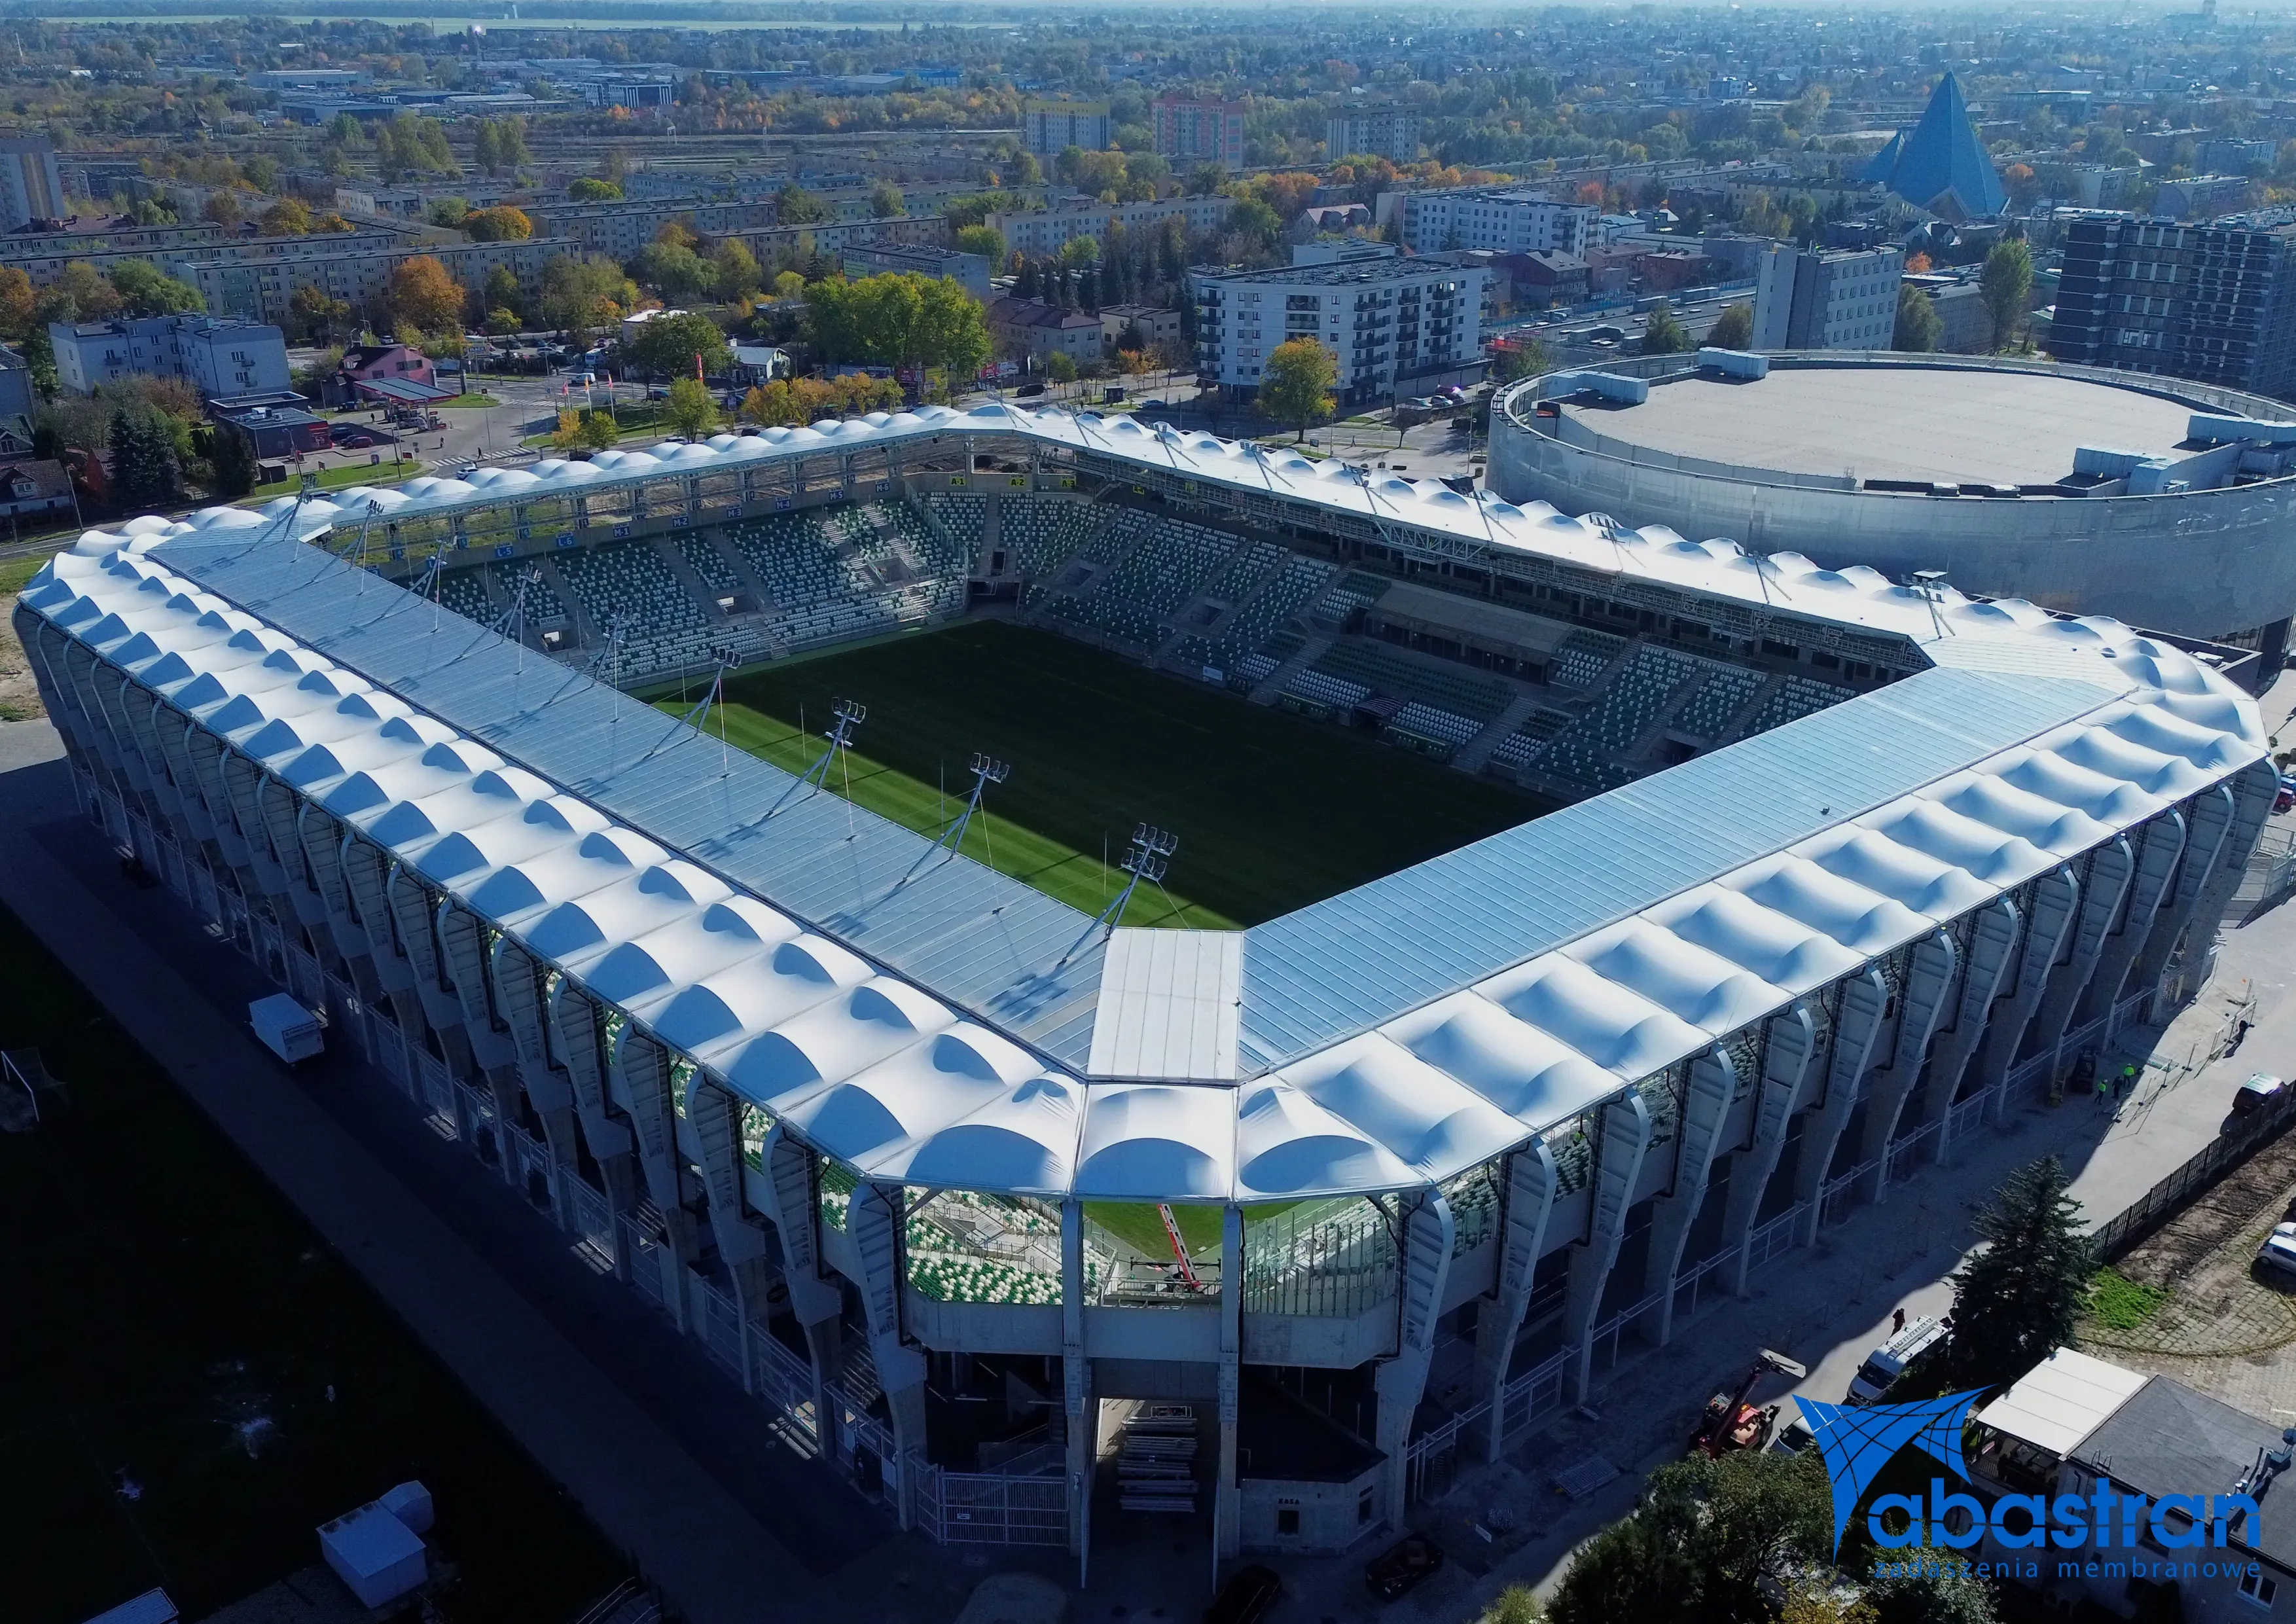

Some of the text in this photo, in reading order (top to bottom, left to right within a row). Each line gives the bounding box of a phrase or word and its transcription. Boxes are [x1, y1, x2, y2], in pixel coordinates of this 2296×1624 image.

[876, 483, 889, 493] M-6
[830, 492, 843, 500] M-5
[776, 501, 791, 510] M-4
[727, 509, 742, 518] M-3
[673, 518, 688, 527] M-2
[614, 528, 629, 537] M-1
[558, 537, 573, 547] L-6
[497, 547, 512, 557] L-5
